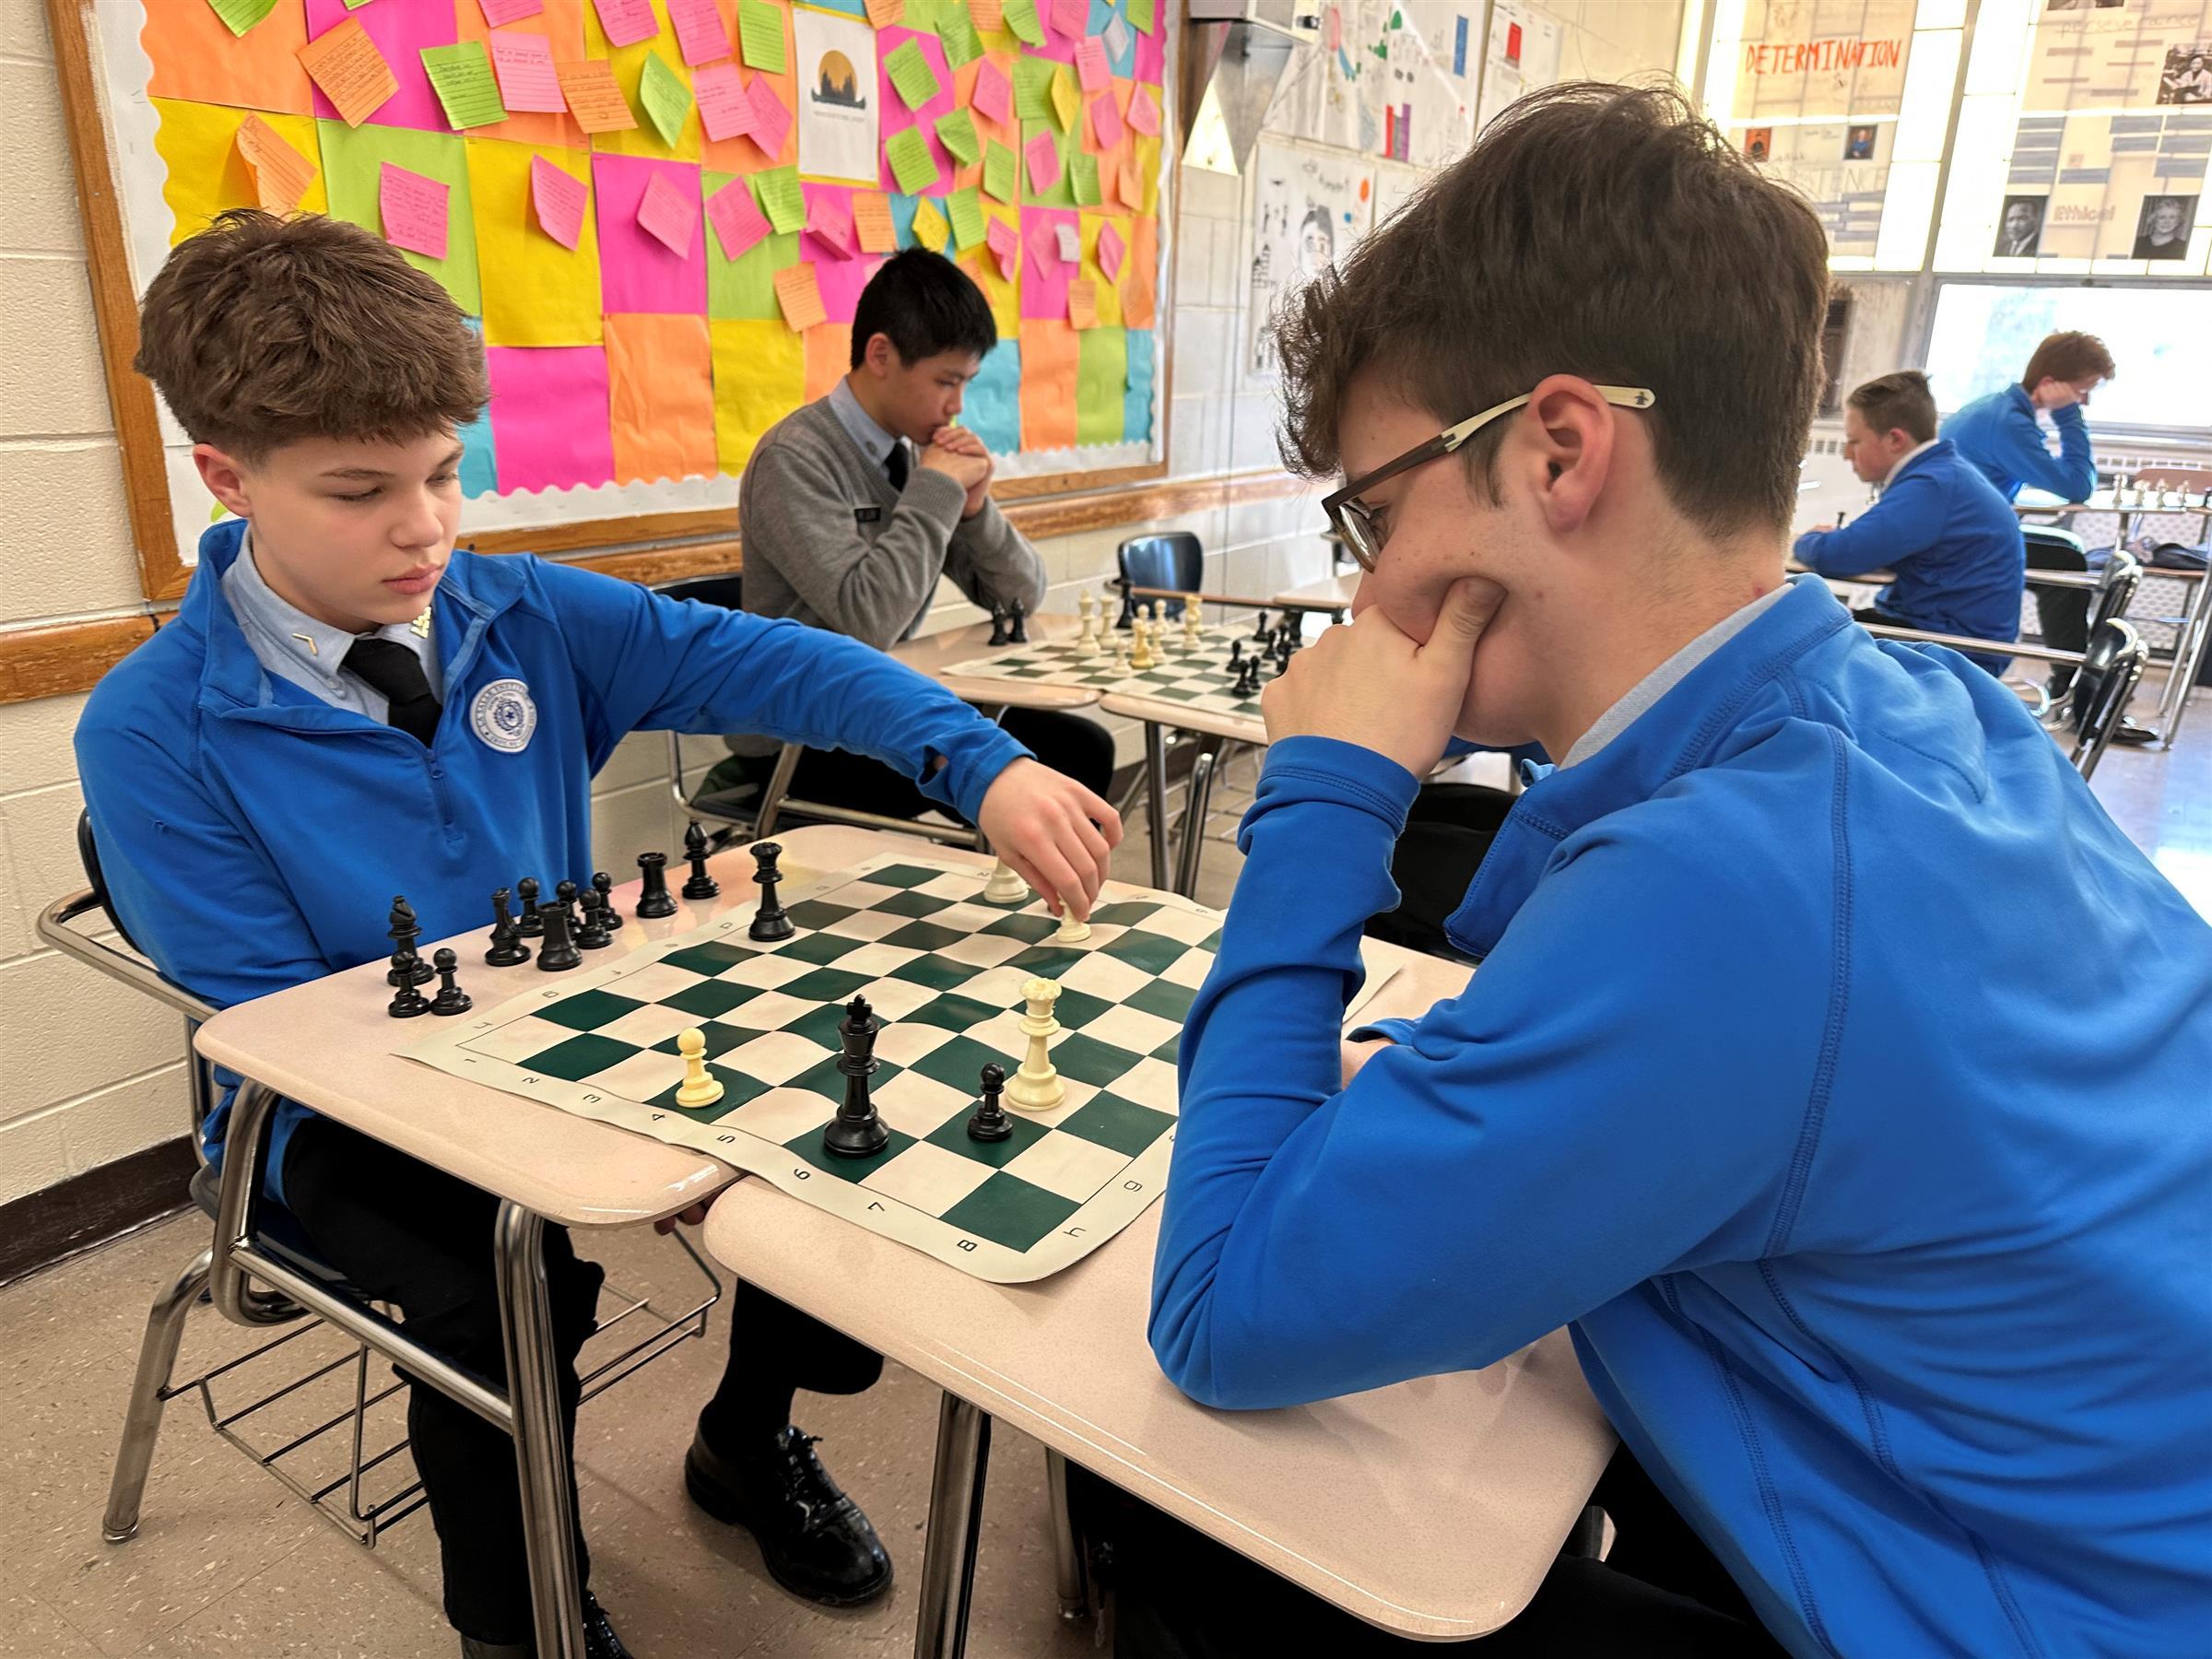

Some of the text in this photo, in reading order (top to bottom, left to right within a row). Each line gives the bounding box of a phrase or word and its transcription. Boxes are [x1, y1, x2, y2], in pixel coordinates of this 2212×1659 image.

[1745, 39, 1902, 76] DETERMINATION
[522, 1077, 540, 1085] 2
[582, 1093, 602, 1104] 3
[652, 1113, 666, 1122] 4
[717, 1135, 736, 1144] 5
[794, 1168, 811, 1181] 6
[868, 1202, 886, 1213] 7
[957, 1239, 978, 1253] 8
